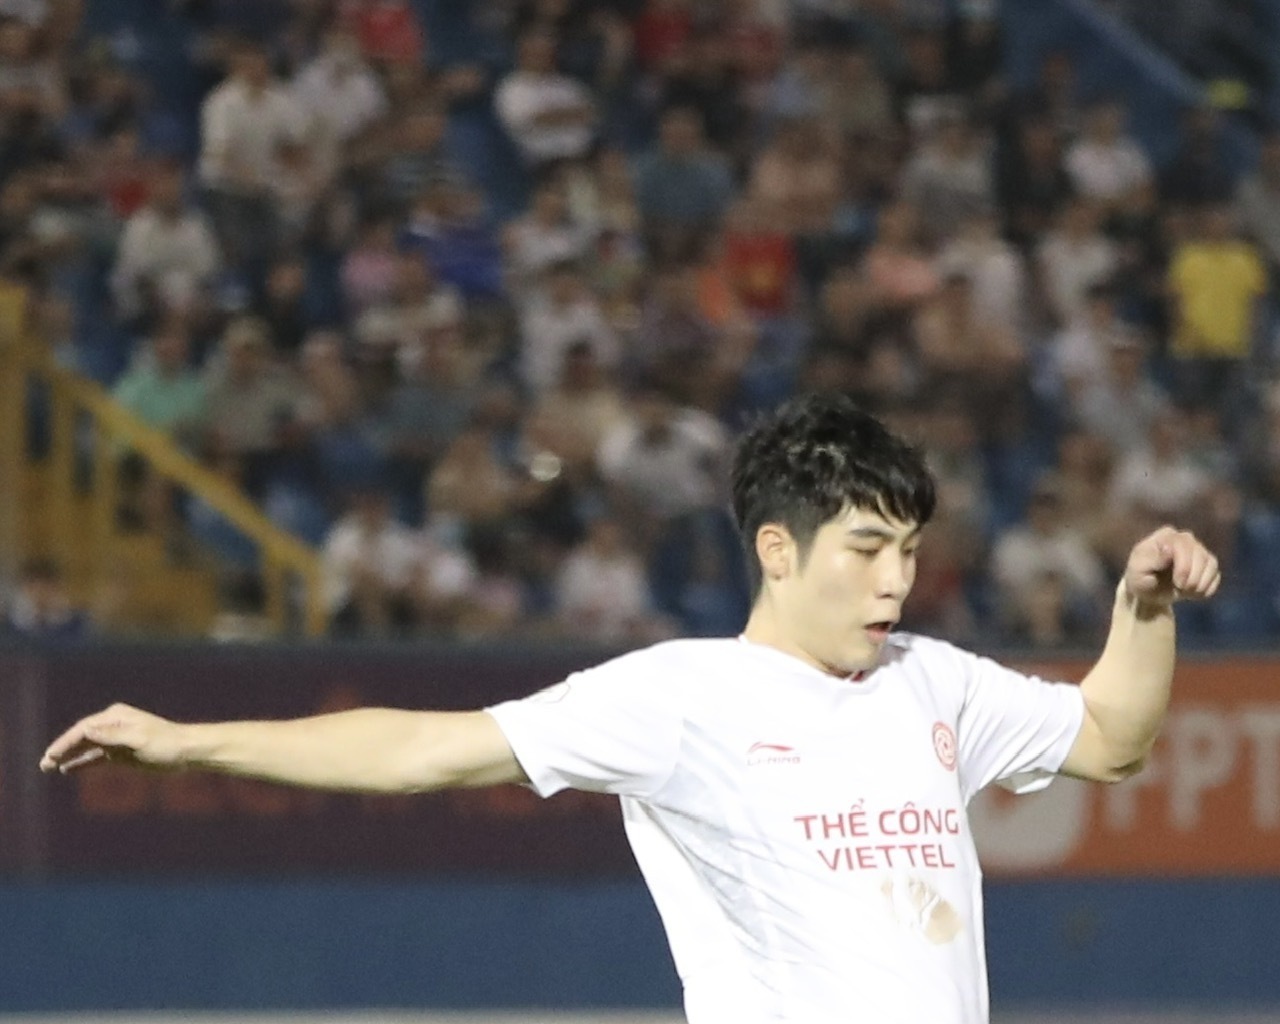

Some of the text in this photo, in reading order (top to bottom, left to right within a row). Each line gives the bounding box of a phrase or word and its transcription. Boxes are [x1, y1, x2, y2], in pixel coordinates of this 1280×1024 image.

[793, 798, 959, 840] THỂ CÔNG
[817, 844, 956, 871] VIETTEL
